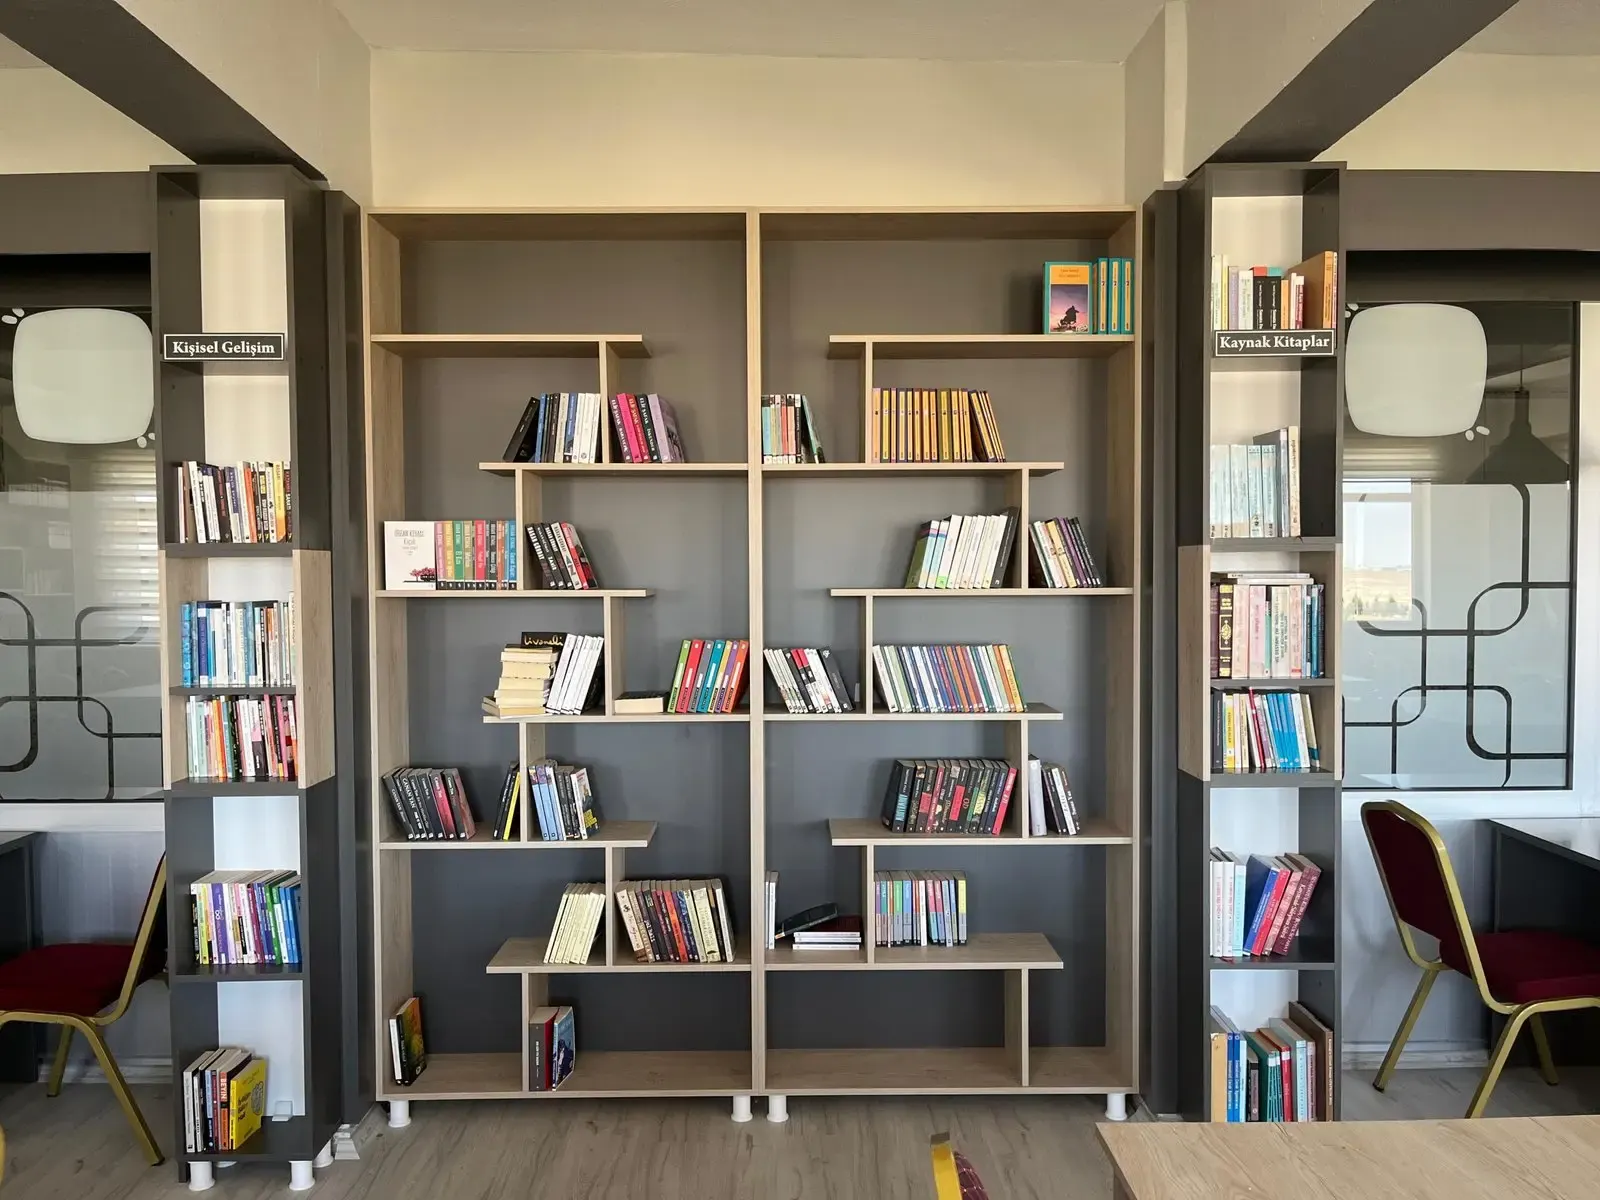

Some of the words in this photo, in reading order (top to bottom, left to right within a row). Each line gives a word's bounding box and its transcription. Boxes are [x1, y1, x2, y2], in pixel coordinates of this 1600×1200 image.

[172, 341, 219, 356] Kişisel
[222, 341, 275, 356] Gelişim
[1220, 336, 1270, 351] Kaynak
[1274, 335, 1330, 350] Kitaplar
